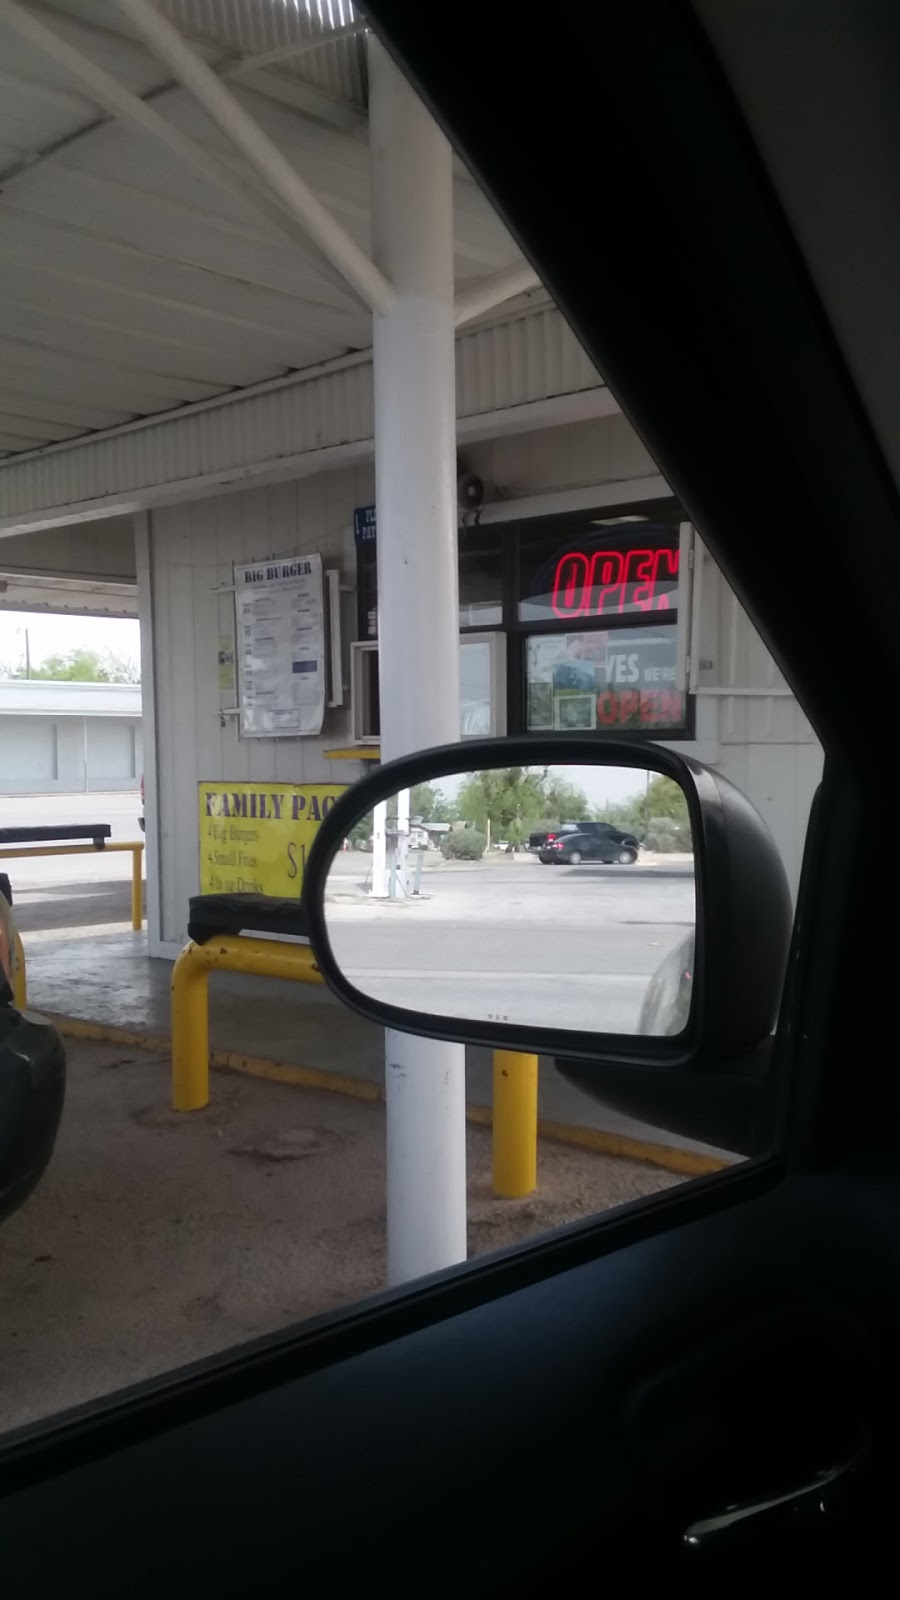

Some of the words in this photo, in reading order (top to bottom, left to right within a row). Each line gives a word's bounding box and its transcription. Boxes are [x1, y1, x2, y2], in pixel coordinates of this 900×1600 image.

[244, 569, 264, 584] BIG
[266, 561, 312, 581] BURGER
[605, 653, 640, 683] YES
[596, 688, 682, 724] OPEN
[205, 792, 286, 820] FAMILY
[291, 794, 341, 821] PAC
[213, 825, 228, 845] Big
[229, 825, 260, 846] Burgers
[213, 850, 236, 866] Small
[238, 851, 257, 868] Fries
[237, 876, 263, 892] Drinks
